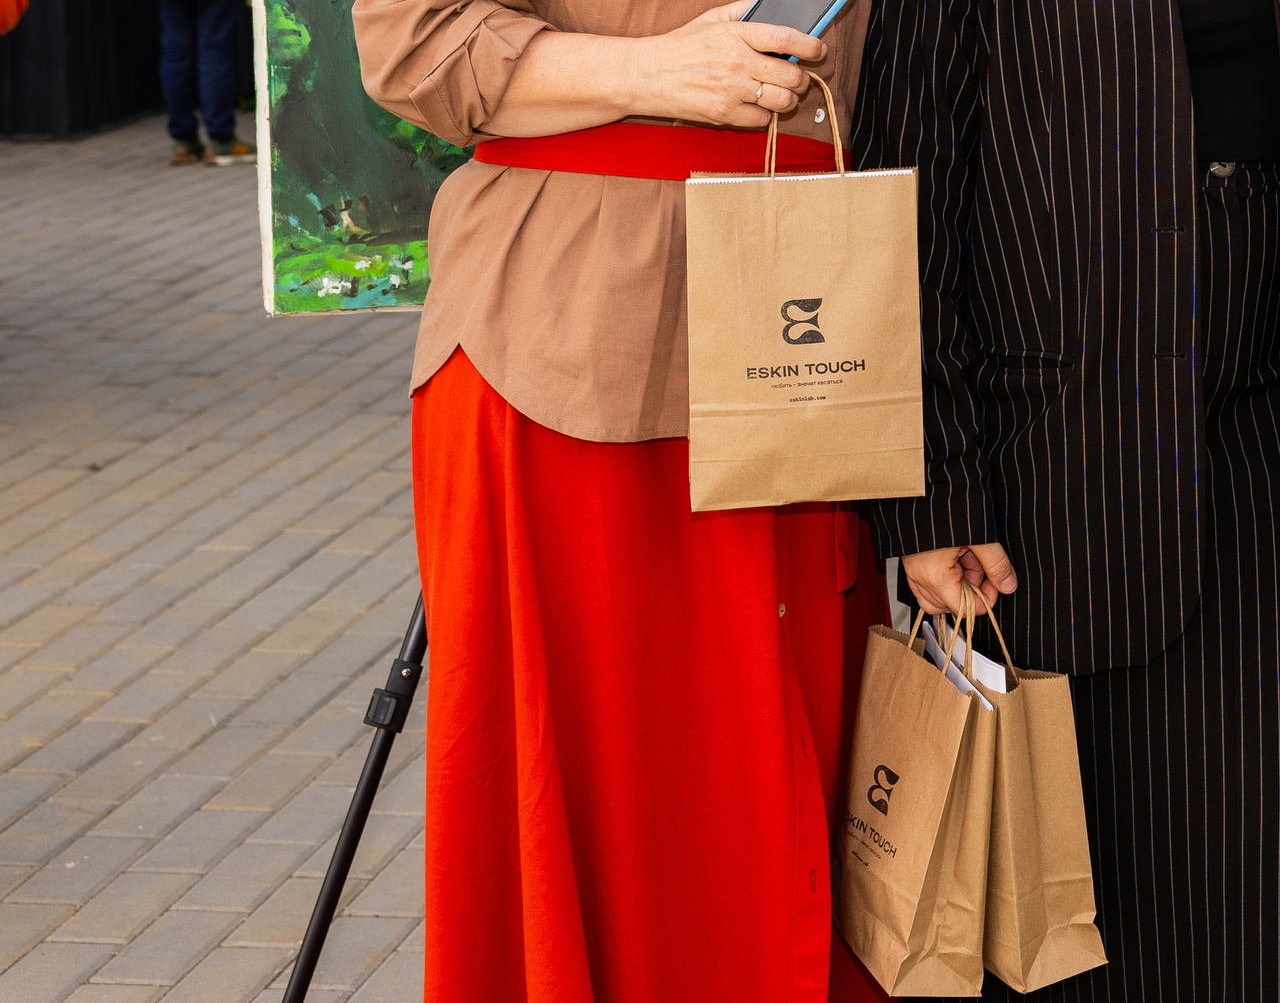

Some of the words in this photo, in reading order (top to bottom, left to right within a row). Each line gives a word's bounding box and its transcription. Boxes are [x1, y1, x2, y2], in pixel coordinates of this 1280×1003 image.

[746, 364, 800, 380] ESKIN
[804, 359, 866, 375] TOUCH
[869, 827, 897, 858] TOUCH
